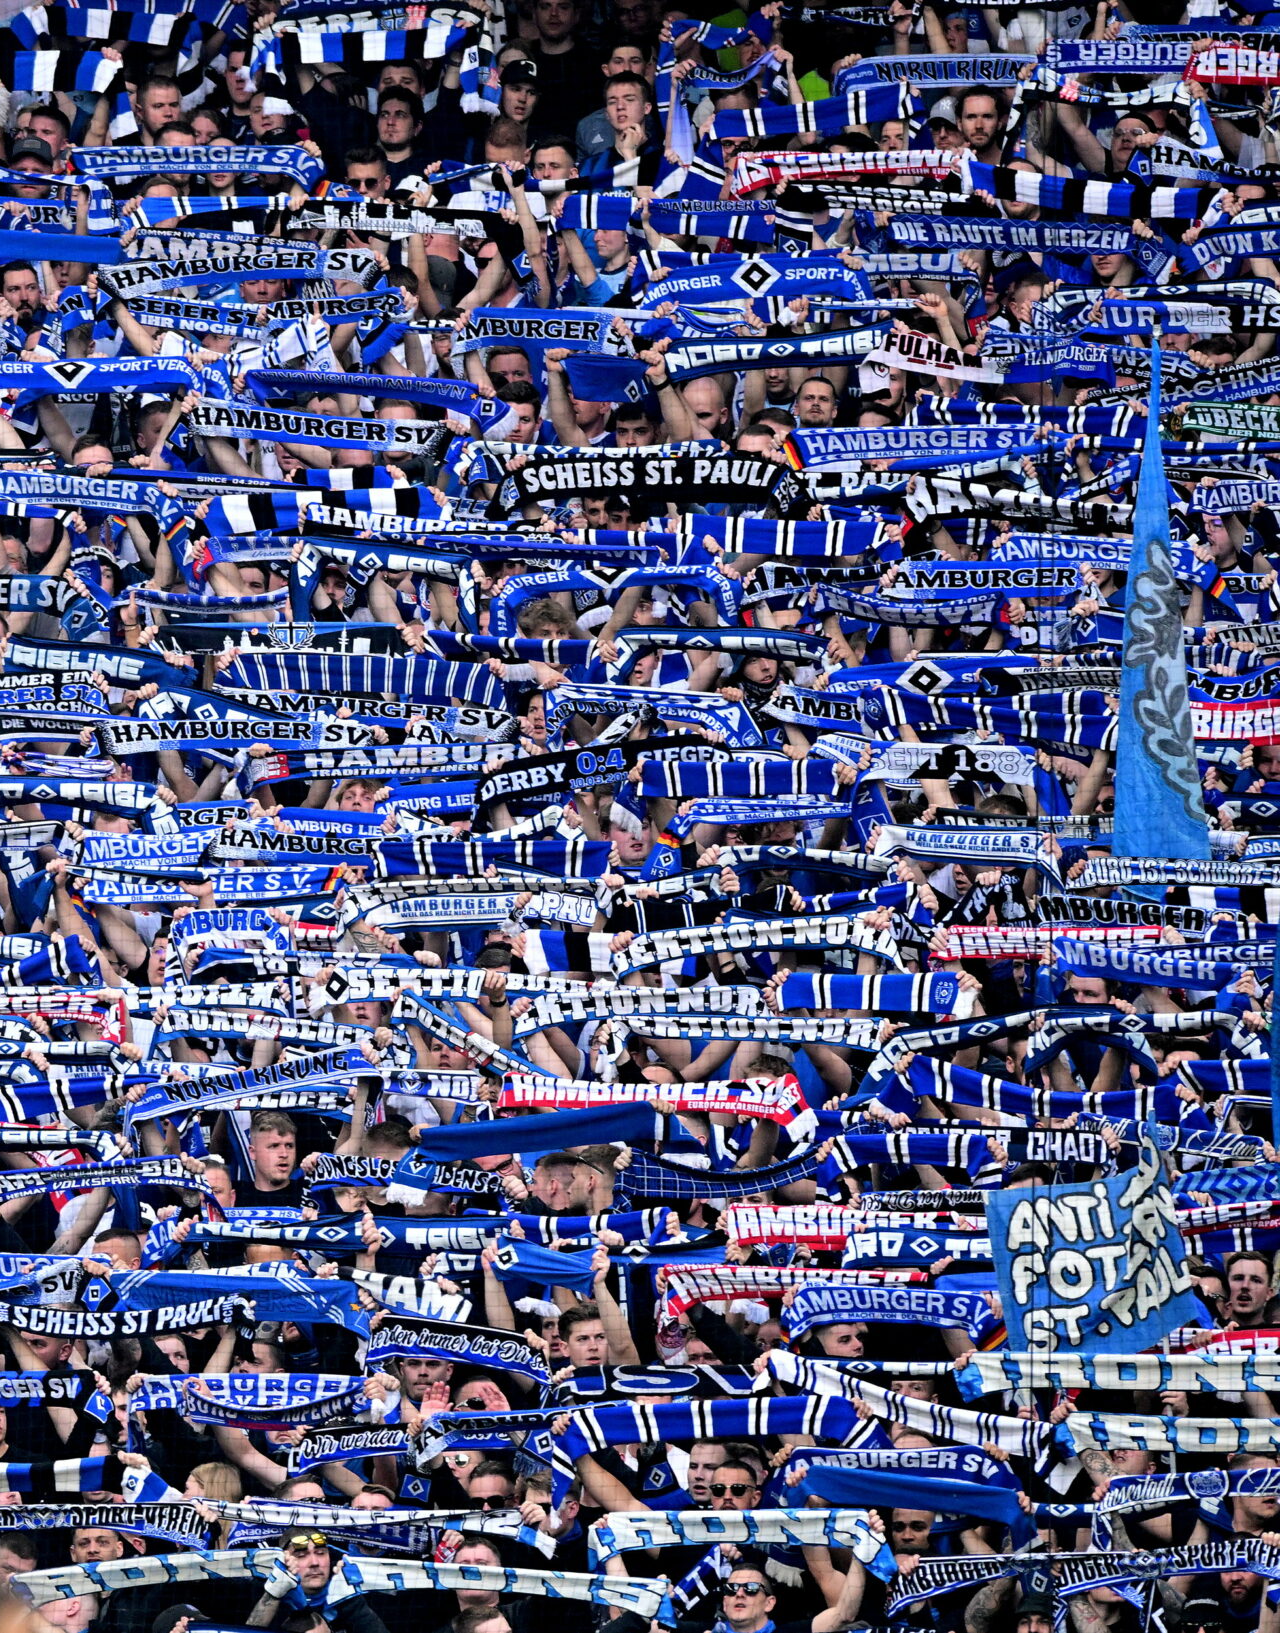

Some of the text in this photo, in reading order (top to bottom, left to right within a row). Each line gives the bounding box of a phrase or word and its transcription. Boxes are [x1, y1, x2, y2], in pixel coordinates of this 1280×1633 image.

[85, 147, 267, 164] HAMBURGER
[893, 223, 1130, 251] DIE RAUTE IM HERZEN
[112, 249, 371, 287] HAMBURGER SV
[178, 319, 228, 333] NOCH
[1166, 305, 1230, 328] DER
[885, 333, 986, 369] FULHAM
[1023, 346, 1108, 367] HAMBURGER
[98, 360, 202, 389] SPORT-VEREIN
[193, 407, 434, 445] HAMBURGER SV
[1184, 404, 1280, 430] LÜBECK
[805, 430, 991, 455] HAMBURGER
[196, 475, 228, 485] SINCE
[525, 456, 776, 492] SCHEISS ST. PAULI
[113, 720, 373, 745] HAMBURGER SV
[458, 709, 510, 732] SV
[658, 705, 732, 736] GEWORDEN
[481, 763, 567, 801] DERBY
[575, 747, 625, 772] 0:4
[267, 870, 311, 889] S.V.
[1008, 1183, 1116, 1253] ANTI
[10, 1303, 224, 1336] SCHEISS ST PAULI
[418, 1328, 470, 1353] immer
[470, 1332, 499, 1357] bei
[500, 1340, 531, 1363] Dir
[50, 1377, 81, 1398] SV
[300, 1438, 337, 1460] Wir
